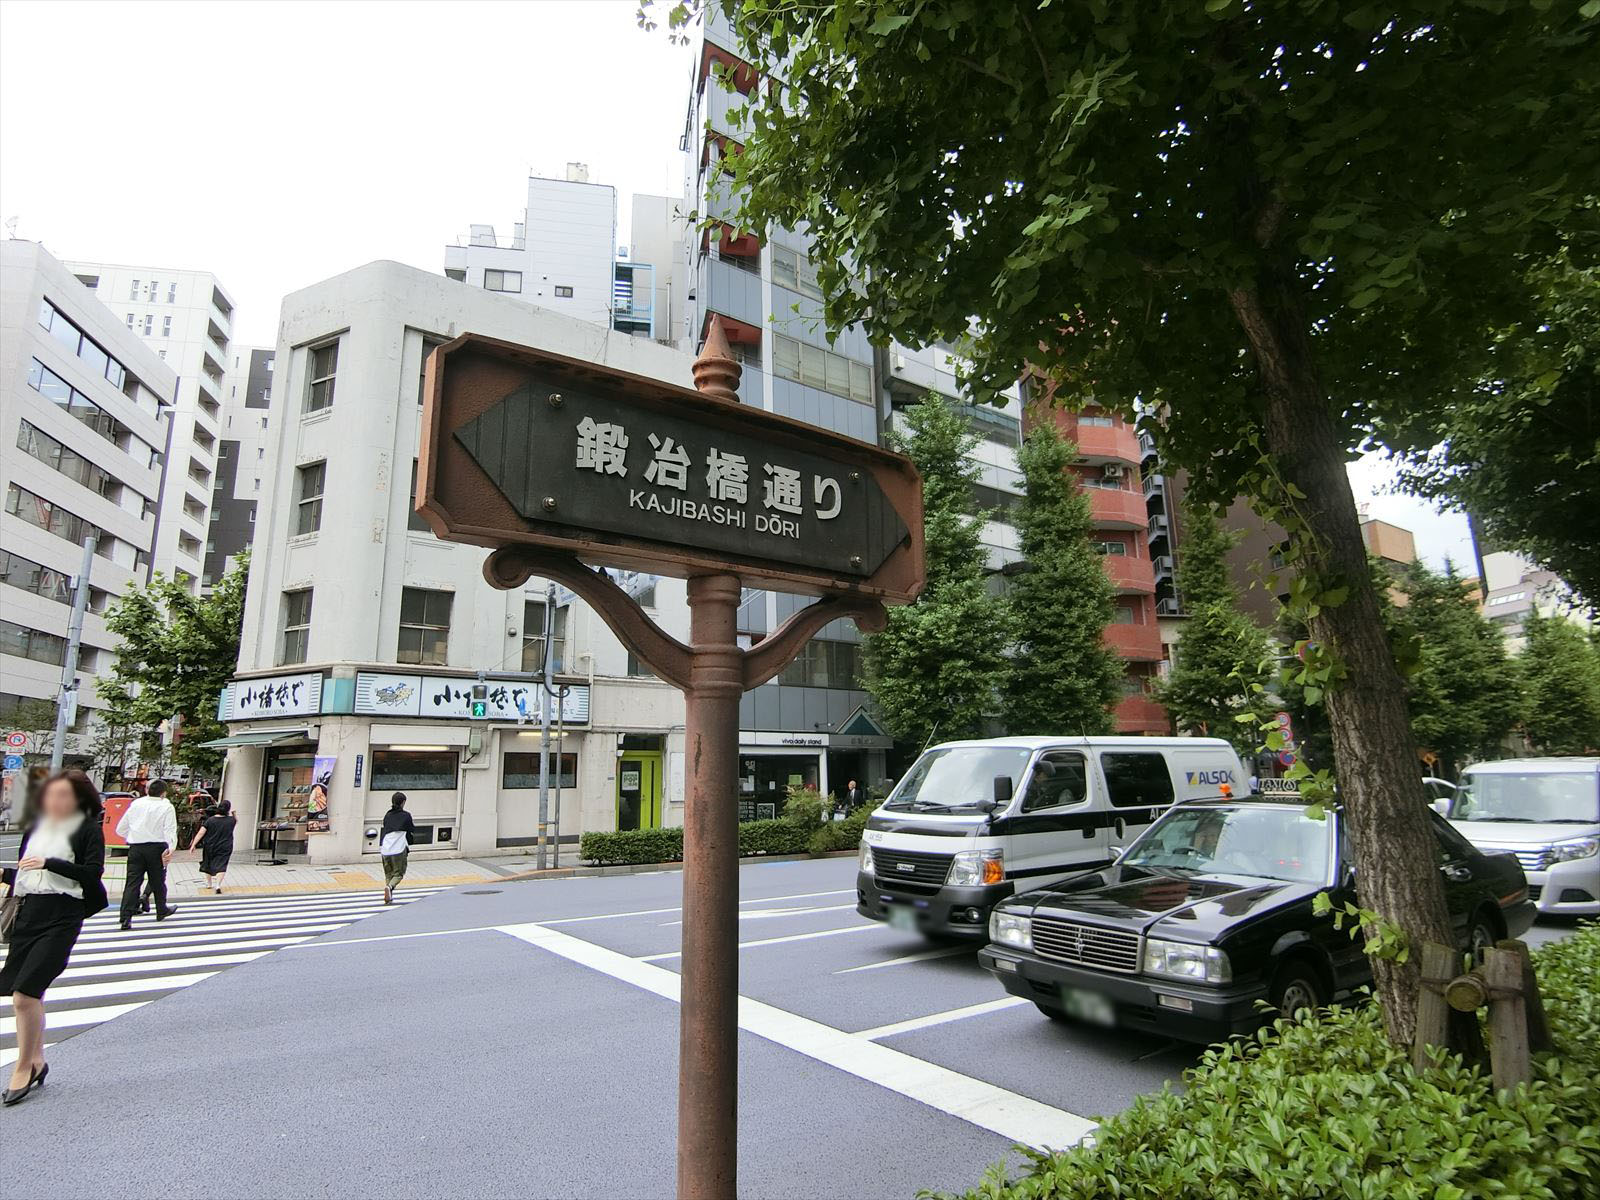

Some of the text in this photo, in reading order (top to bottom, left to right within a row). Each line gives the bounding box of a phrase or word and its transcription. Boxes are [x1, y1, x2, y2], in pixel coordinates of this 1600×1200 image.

[576, 416, 842, 520] 鍛冶橋通り
[630, 489, 800, 539] KAJIBASHI DŌRI
[1199, 770, 1235, 784] ALSOK
[1258, 778, 1282, 789] TAXI
